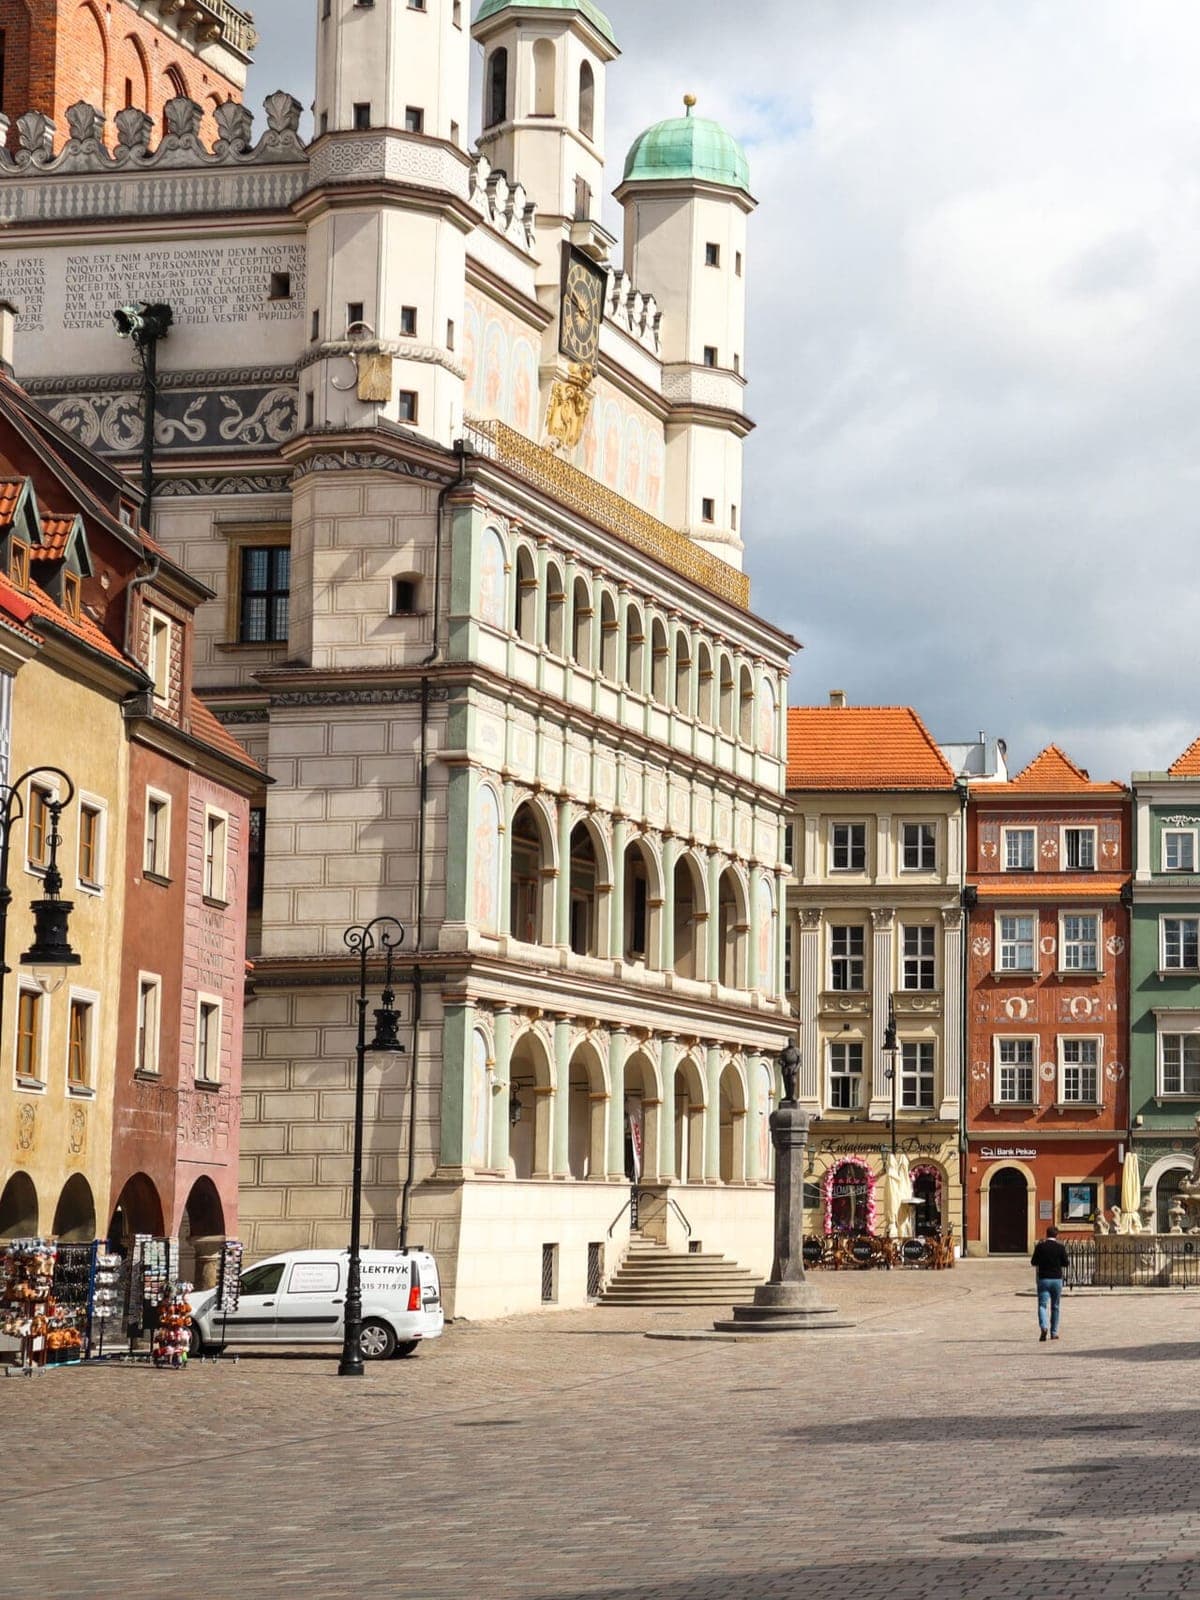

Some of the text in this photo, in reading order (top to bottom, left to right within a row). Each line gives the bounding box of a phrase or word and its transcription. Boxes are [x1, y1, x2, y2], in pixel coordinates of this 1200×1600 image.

[17, 258, 45, 267] IVSTE
[67, 256, 89, 265] NON
[94, 255, 111, 263] EST
[115, 253, 141, 262] ENIM
[143, 252, 170, 260] APVD
[174, 249, 223, 259] DOMINVM
[228, 247, 256, 257] DEVM
[65, 273, 103, 283] CVPIDO
[108, 271, 160, 281] MVNERVM
[179, 267, 217, 277] VIDVAE
[221, 267, 233, 275] ET
[240, 264, 281, 274] PVPILLO
[66, 264, 116, 274] INIQVITAS
[121, 263, 142, 271] NEC
[150, 259, 220, 270] PERSONARVM
[126, 282, 135, 290] SI
[139, 279, 185, 289] LAESERIS
[192, 277, 212, 286] EOS
[24, 295, 43, 304] PER
[65, 293, 84, 302] TVR
[90, 292, 103, 300] AD
[108, 291, 122, 300] ME
[128, 290, 139, 298] ET
[144, 289, 165, 298] EGO
[170, 287, 209, 297] AVDIAM
[25, 304, 42, 313] EST
[65, 302, 87, 310] RVM
[95, 301, 106, 309] ET
[195, 295, 228, 305] FVROR
[236, 294, 263, 303] MEVS
[212, 304, 224, 313] ET
[232, 303, 265, 312] ERVNT
[63, 320, 104, 329] VESTRAE
[214, 313, 247, 323] VESTRI
[258, 311, 292, 321] PVPILLI
[997, 1147, 1037, 1156] Bank Pekao
